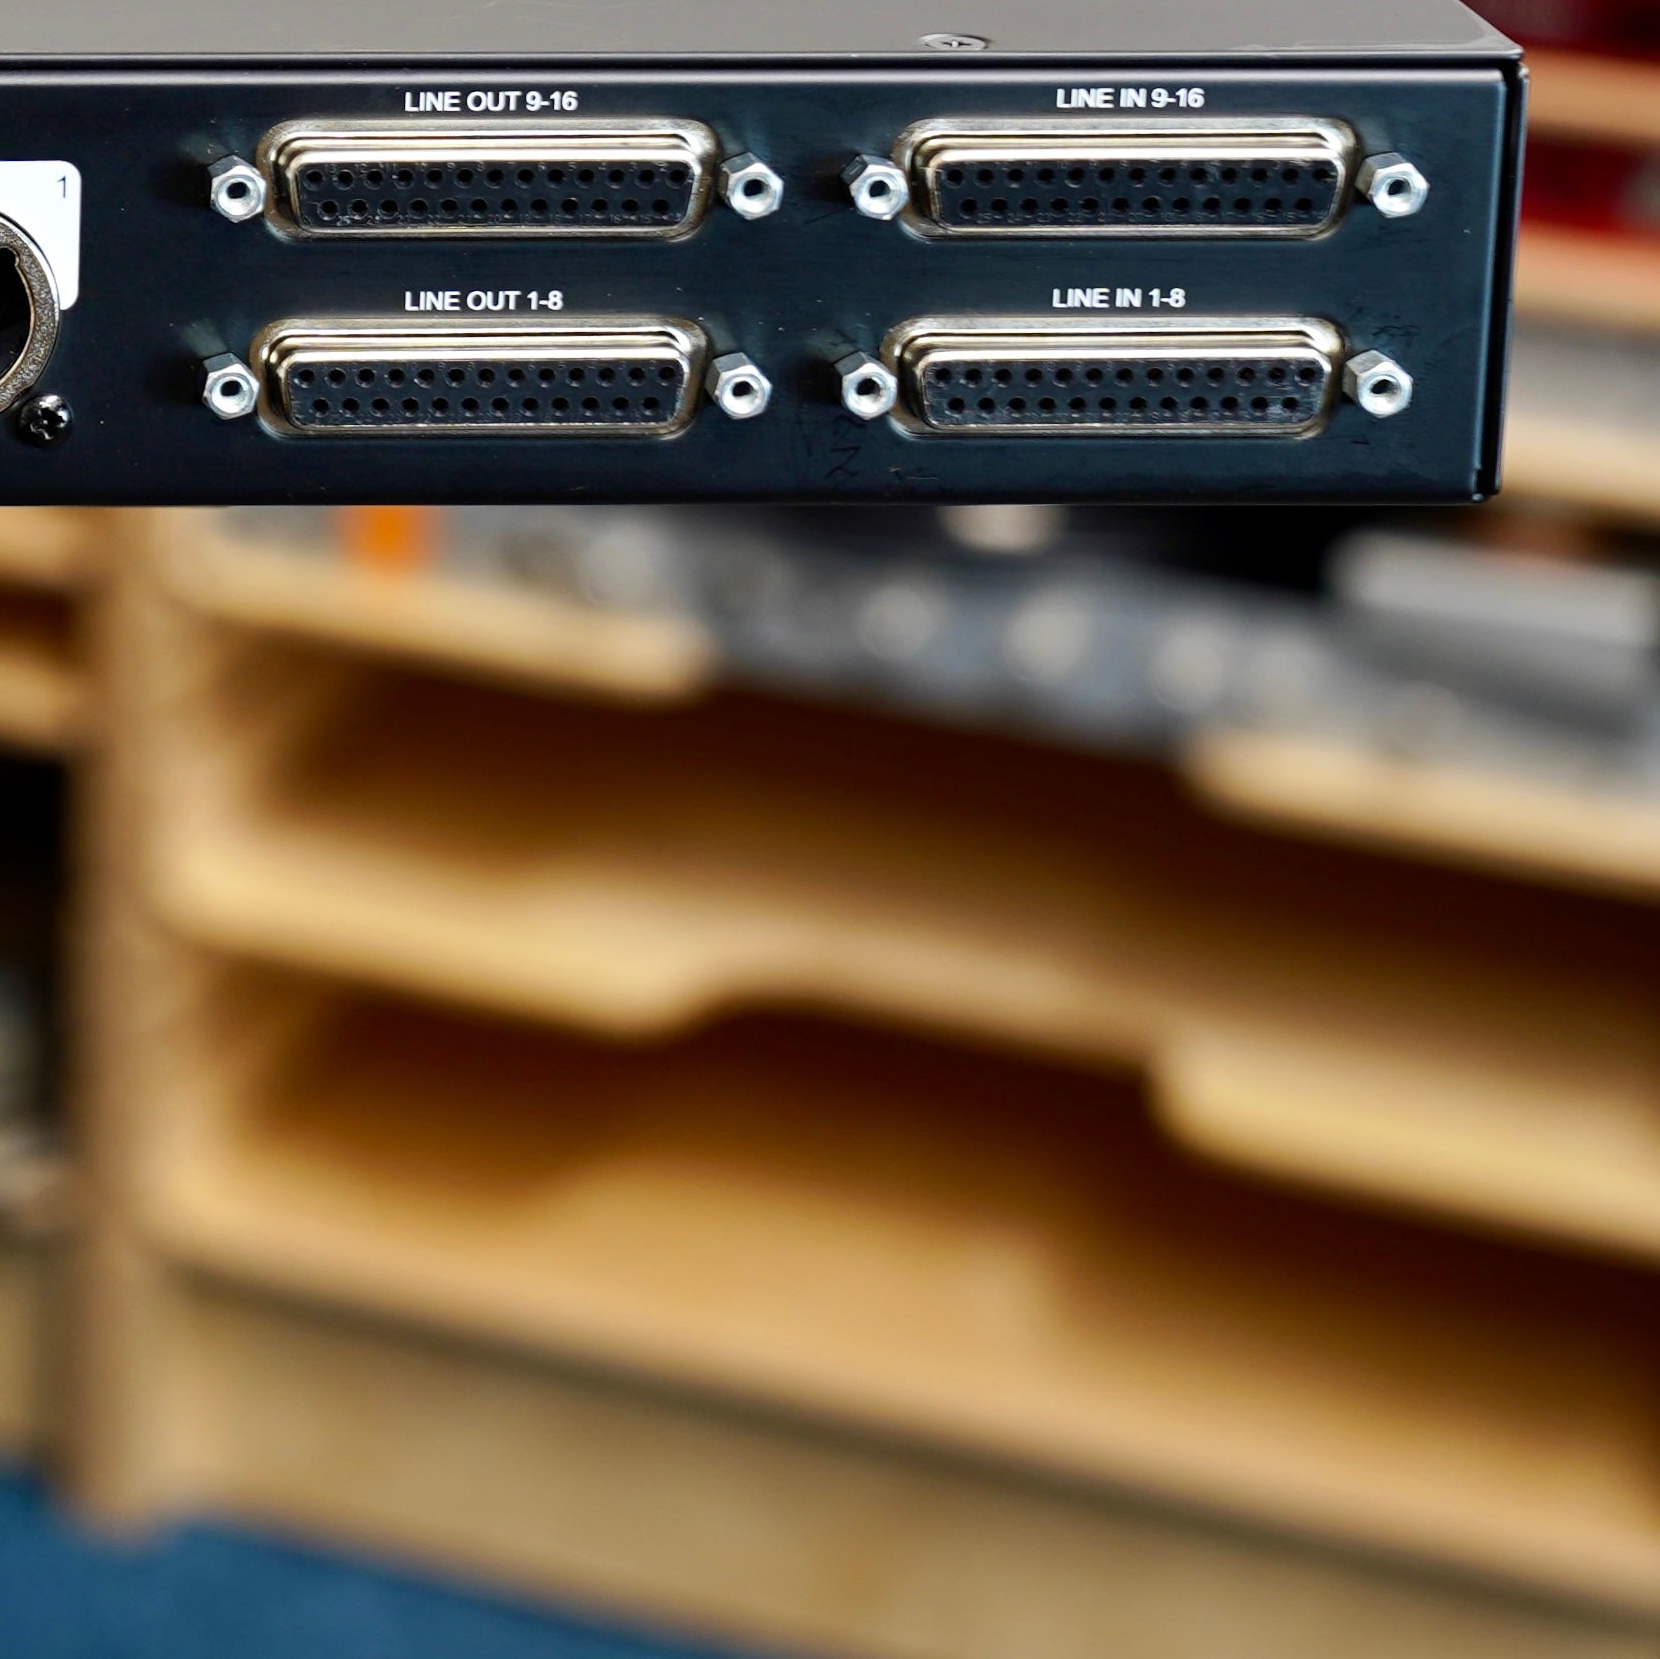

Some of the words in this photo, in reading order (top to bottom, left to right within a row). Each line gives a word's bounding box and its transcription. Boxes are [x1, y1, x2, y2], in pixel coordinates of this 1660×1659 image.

[404, 91, 461, 112] LINE
[466, 90, 522, 112] OUT
[525, 91, 579, 112] 9-16
[1056, 87, 1115, 109] LINE
[1119, 87, 1147, 108] IN
[1150, 87, 1205, 109] 9-16
[56, 175, 67, 198] 1
[404, 291, 461, 311] LINE
[466, 290, 521, 311] OUT
[527, 290, 564, 311] 1-8
[1052, 287, 1111, 309] LINE
[1115, 287, 1143, 308] IN
[1148, 287, 1187, 309] 1-8
